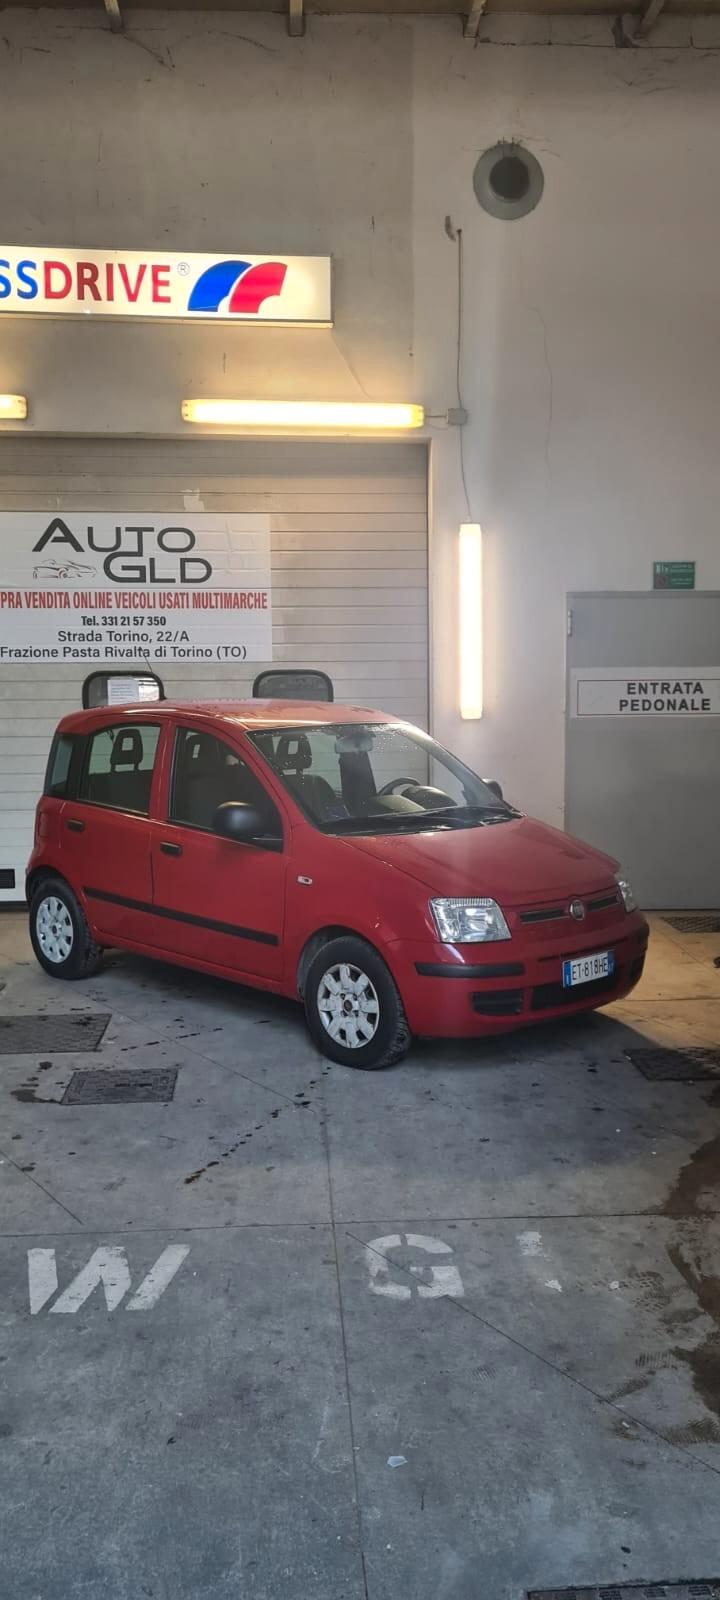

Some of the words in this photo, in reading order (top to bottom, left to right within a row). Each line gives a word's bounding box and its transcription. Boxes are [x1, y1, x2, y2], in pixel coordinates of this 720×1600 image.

[32, 517, 196, 553] AUTO
[103, 551, 212, 583] GLD
[0, 591, 22, 609] PRA
[24, 591, 70, 609] VENDITA
[73, 591, 112, 609] ONLINE
[115, 591, 155, 609] VEICOLI
[159, 591, 189, 609] USATI
[192, 591, 268, 609] MULTIMARCHE
[81, 616, 99, 626] Tel.
[101, 616, 118, 626] 331
[120, 616, 130, 626] 21
[133, 616, 144, 626] 57
[147, 616, 166, 626] 350
[58, 630, 102, 642] Strada
[106, 630, 152, 644] Torino,
[156, 630, 190, 643] 22/A
[0, 646, 59, 658] Frazione
[63, 646, 100, 658] Pasta
[105, 646, 150, 658] Rivalta
[154, 646, 168, 658] di
[170, 646, 213, 658] Torino
[217, 646, 247, 661] (TO)
[627, 682, 704, 695] ENTRATA
[619, 698, 711, 712] PEDONALE
